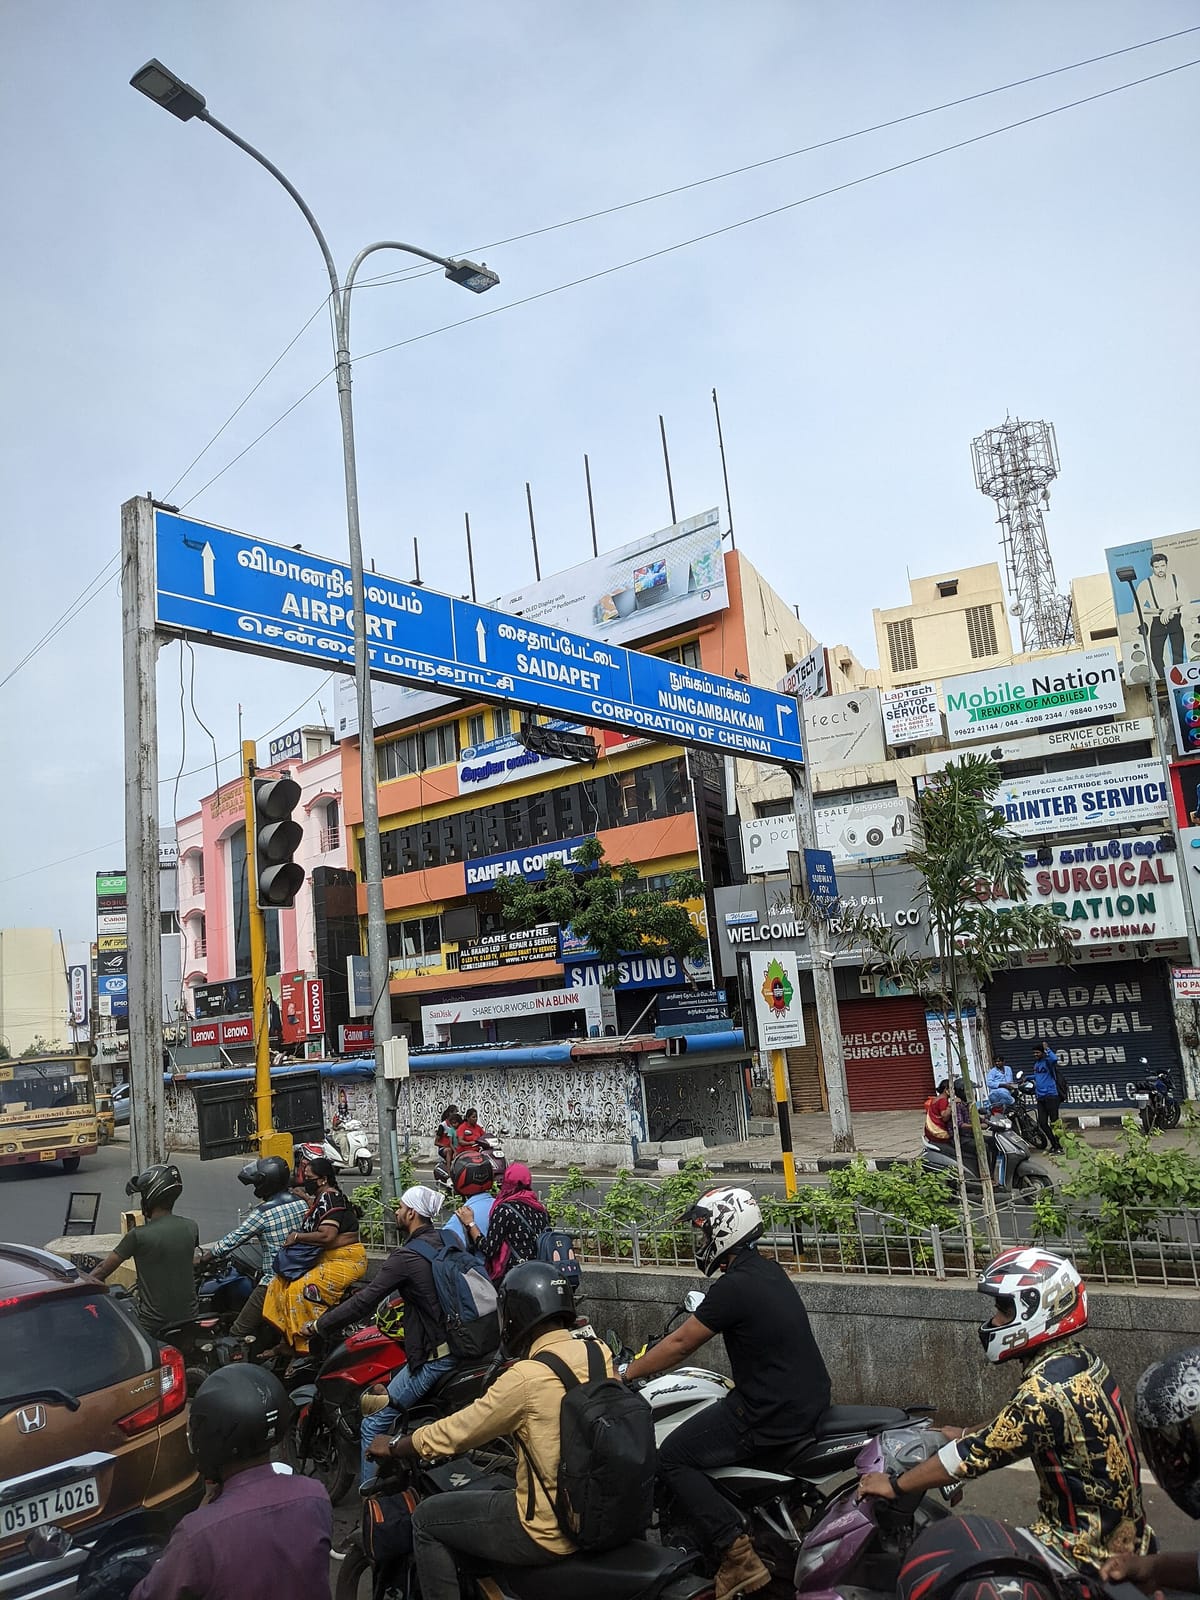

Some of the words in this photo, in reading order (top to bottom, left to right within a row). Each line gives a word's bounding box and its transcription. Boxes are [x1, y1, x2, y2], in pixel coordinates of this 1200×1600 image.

[525, 603, 538, 614] OLED
[538, 598, 555, 611] Display
[556, 594, 586, 610] Performance
[498, 623, 620, 669] சைதாப்பேட்டை
[384, 652, 515, 692] மாநகராட்சி
[517, 653, 600, 691] SAIDAPET
[669, 671, 751, 704] நுங்கம்பாக்கம்
[947, 682, 1025, 712] Mobile
[1032, 667, 1116, 696] Nation
[658, 690, 764, 732] NUNGAMBAKKAM
[886, 703, 936, 720] SERVICE
[892, 697, 928, 710] LAPTOP
[981, 703, 1022, 718] REWORK
[1024, 699, 1039, 710] OF
[1041, 690, 1085, 707] MOBILES
[591, 700, 694, 735] CORPORATION
[699, 726, 715, 740] OF
[719, 730, 771, 753] CHENNAI
[954, 726, 975, 736] 99622
[976, 722, 999, 732] 41144
[1005, 719, 1018, 727] 044
[1025, 715, 1043, 724] 4208
[1045, 711, 1063, 721] 2344
[1069, 706, 1092, 716] 98840
[1095, 701, 1118, 712] 19530
[1049, 729, 1093, 745] SERVICE
[1096, 720, 1140, 737] CENTRE
[1070, 741, 1079, 750] At
[1093, 735, 1121, 747] FLOOR
[1022, 786, 1056, 797] PERFECT
[1058, 780, 1102, 793] CARTRIDGE
[1103, 773, 1149, 785] SOLUTIONS
[745, 819, 771, 829] CCTV
[773, 817, 784, 825] IN
[1059, 815, 1078, 823] EPSON
[769, 823, 831, 844] perct
[815, 864, 826, 873] USE
[1036, 858, 1174, 896] SURGICAL
[727, 920, 806, 944] WELCOME
[895, 908, 920, 926] CO
[460, 949, 470, 957] ALL
[489, 945, 500, 953] LED
[509, 941, 528, 950] REPAIR
[533, 936, 557, 946] SERVICE
[468, 939, 480, 947] TV
[481, 934, 507, 945] CARE
[509, 927, 549, 941] CENTRE
[571, 955, 677, 987] SAMSUNG
[108, 980, 124, 988] TVS
[312, 983, 321, 1029] Lenovo
[472, 1006, 492, 1016] SHARE
[492, 1004, 511, 1014] YOUR
[510, 1001, 535, 1012] WORLD
[535, 997, 545, 1009] IN
[546, 998, 552, 1007] A
[1011, 981, 1142, 1012] MADAN
[429, 1009, 452, 1019] SanDisk
[192, 1030, 215, 1042] Lenovo
[223, 1026, 248, 1038] Lenovo
[344, 1029, 363, 1040] Canon
[1000, 1011, 1152, 1040] SURGICAL
[841, 1029, 918, 1047] WELCOME
[843, 1043, 905, 1061] SURGICAL
[908, 1042, 925, 1055] CO
[1055, 1045, 1126, 1067] ORPN
[5, 1509, 26, 1530] 05
[29, 1497, 51, 1524] BT
[54, 1484, 94, 1514] 4026
